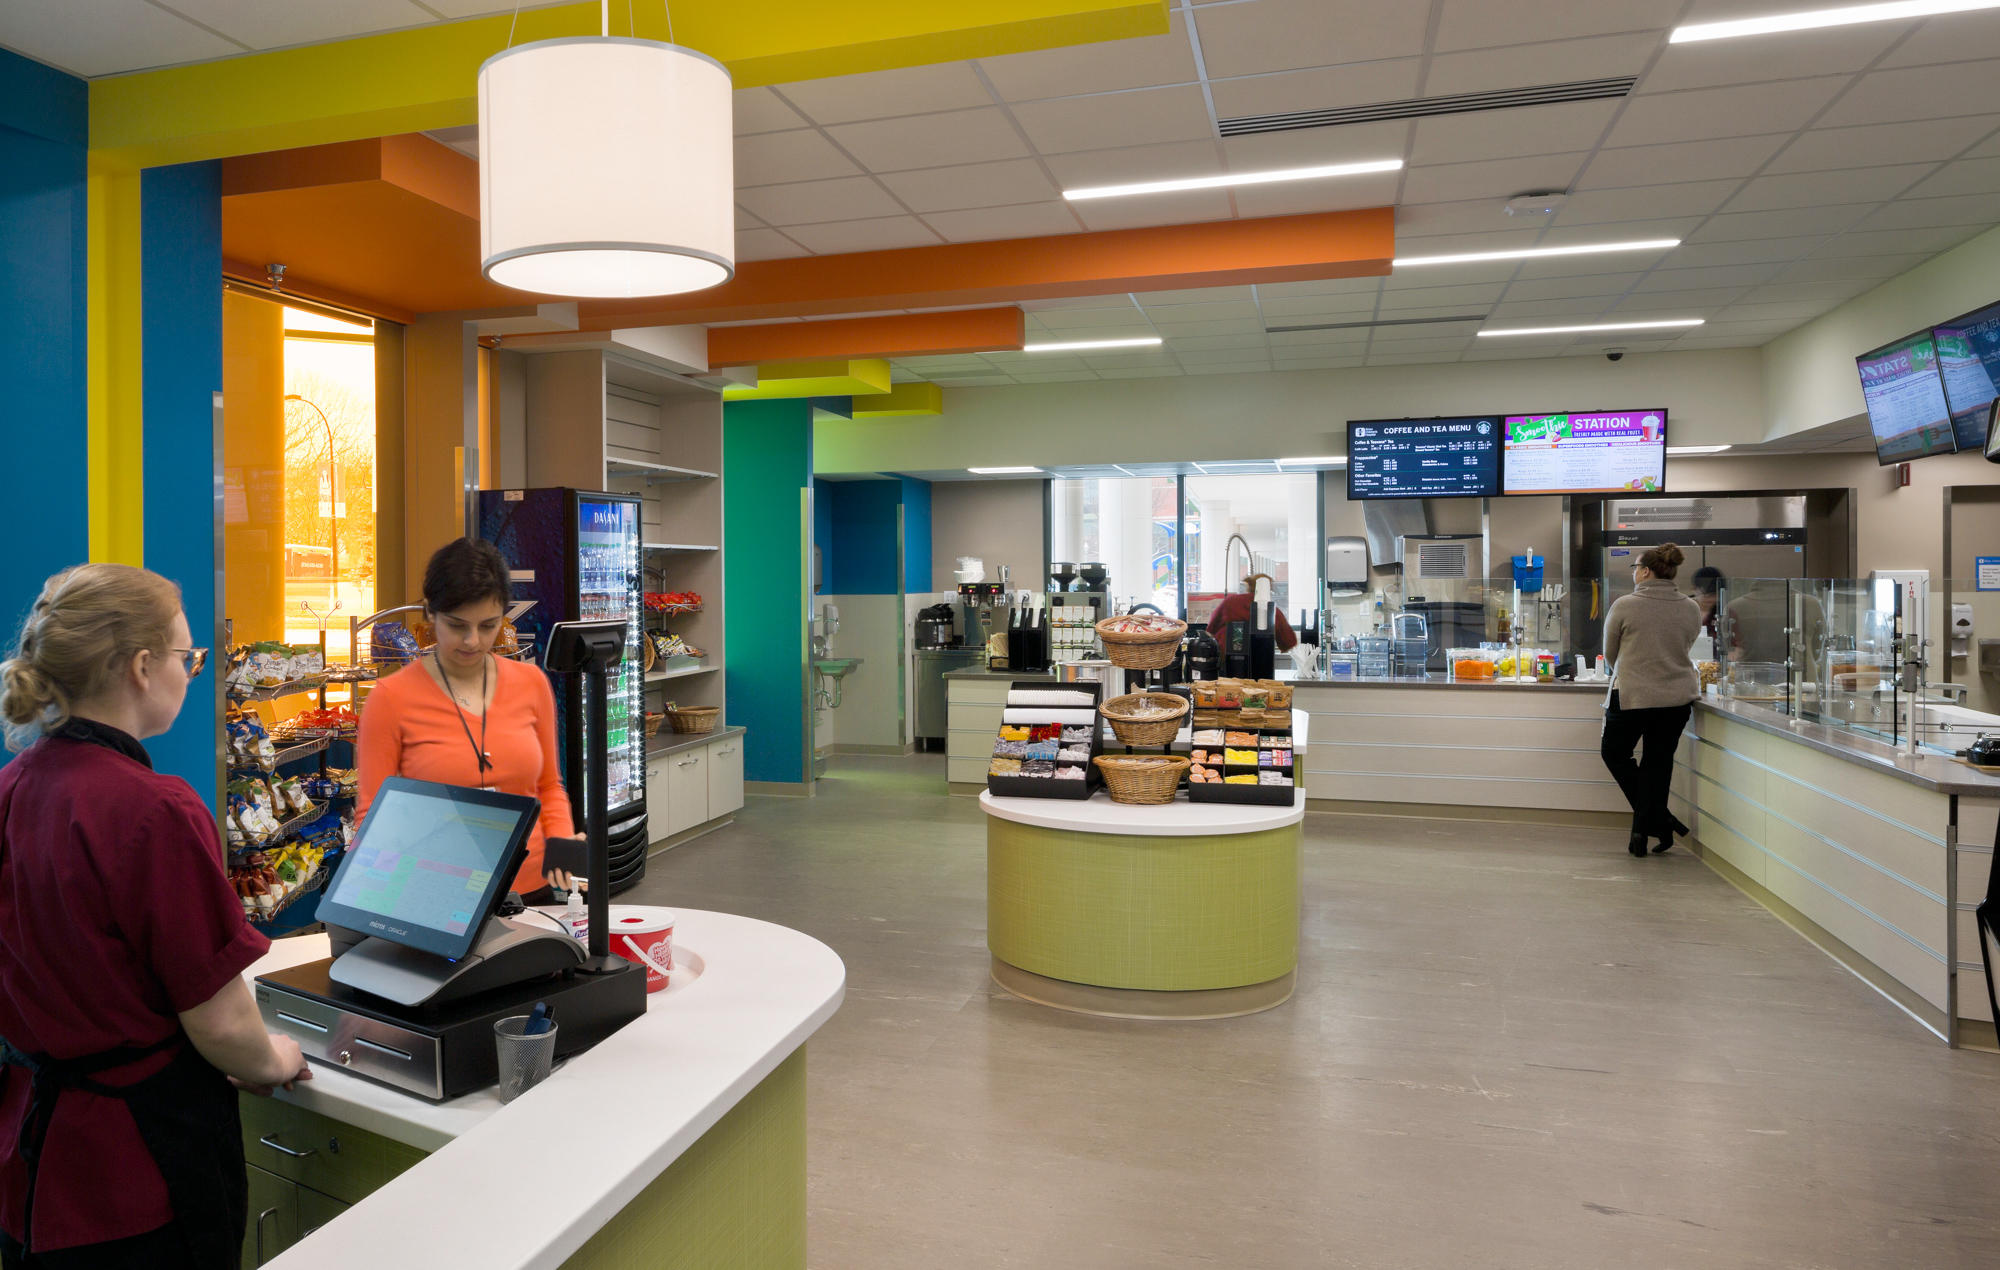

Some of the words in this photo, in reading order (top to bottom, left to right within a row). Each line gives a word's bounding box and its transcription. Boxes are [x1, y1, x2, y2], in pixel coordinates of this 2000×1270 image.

[1383, 426, 1412, 435] COFFEE
[1414, 425, 1431, 434] AND
[1432, 425, 1447, 433] TEA
[1448, 424, 1471, 433] MENU
[1516, 416, 1567, 442] Smoothie
[1574, 416, 1631, 430] STATION
[594, 511, 620, 526] DASANI
